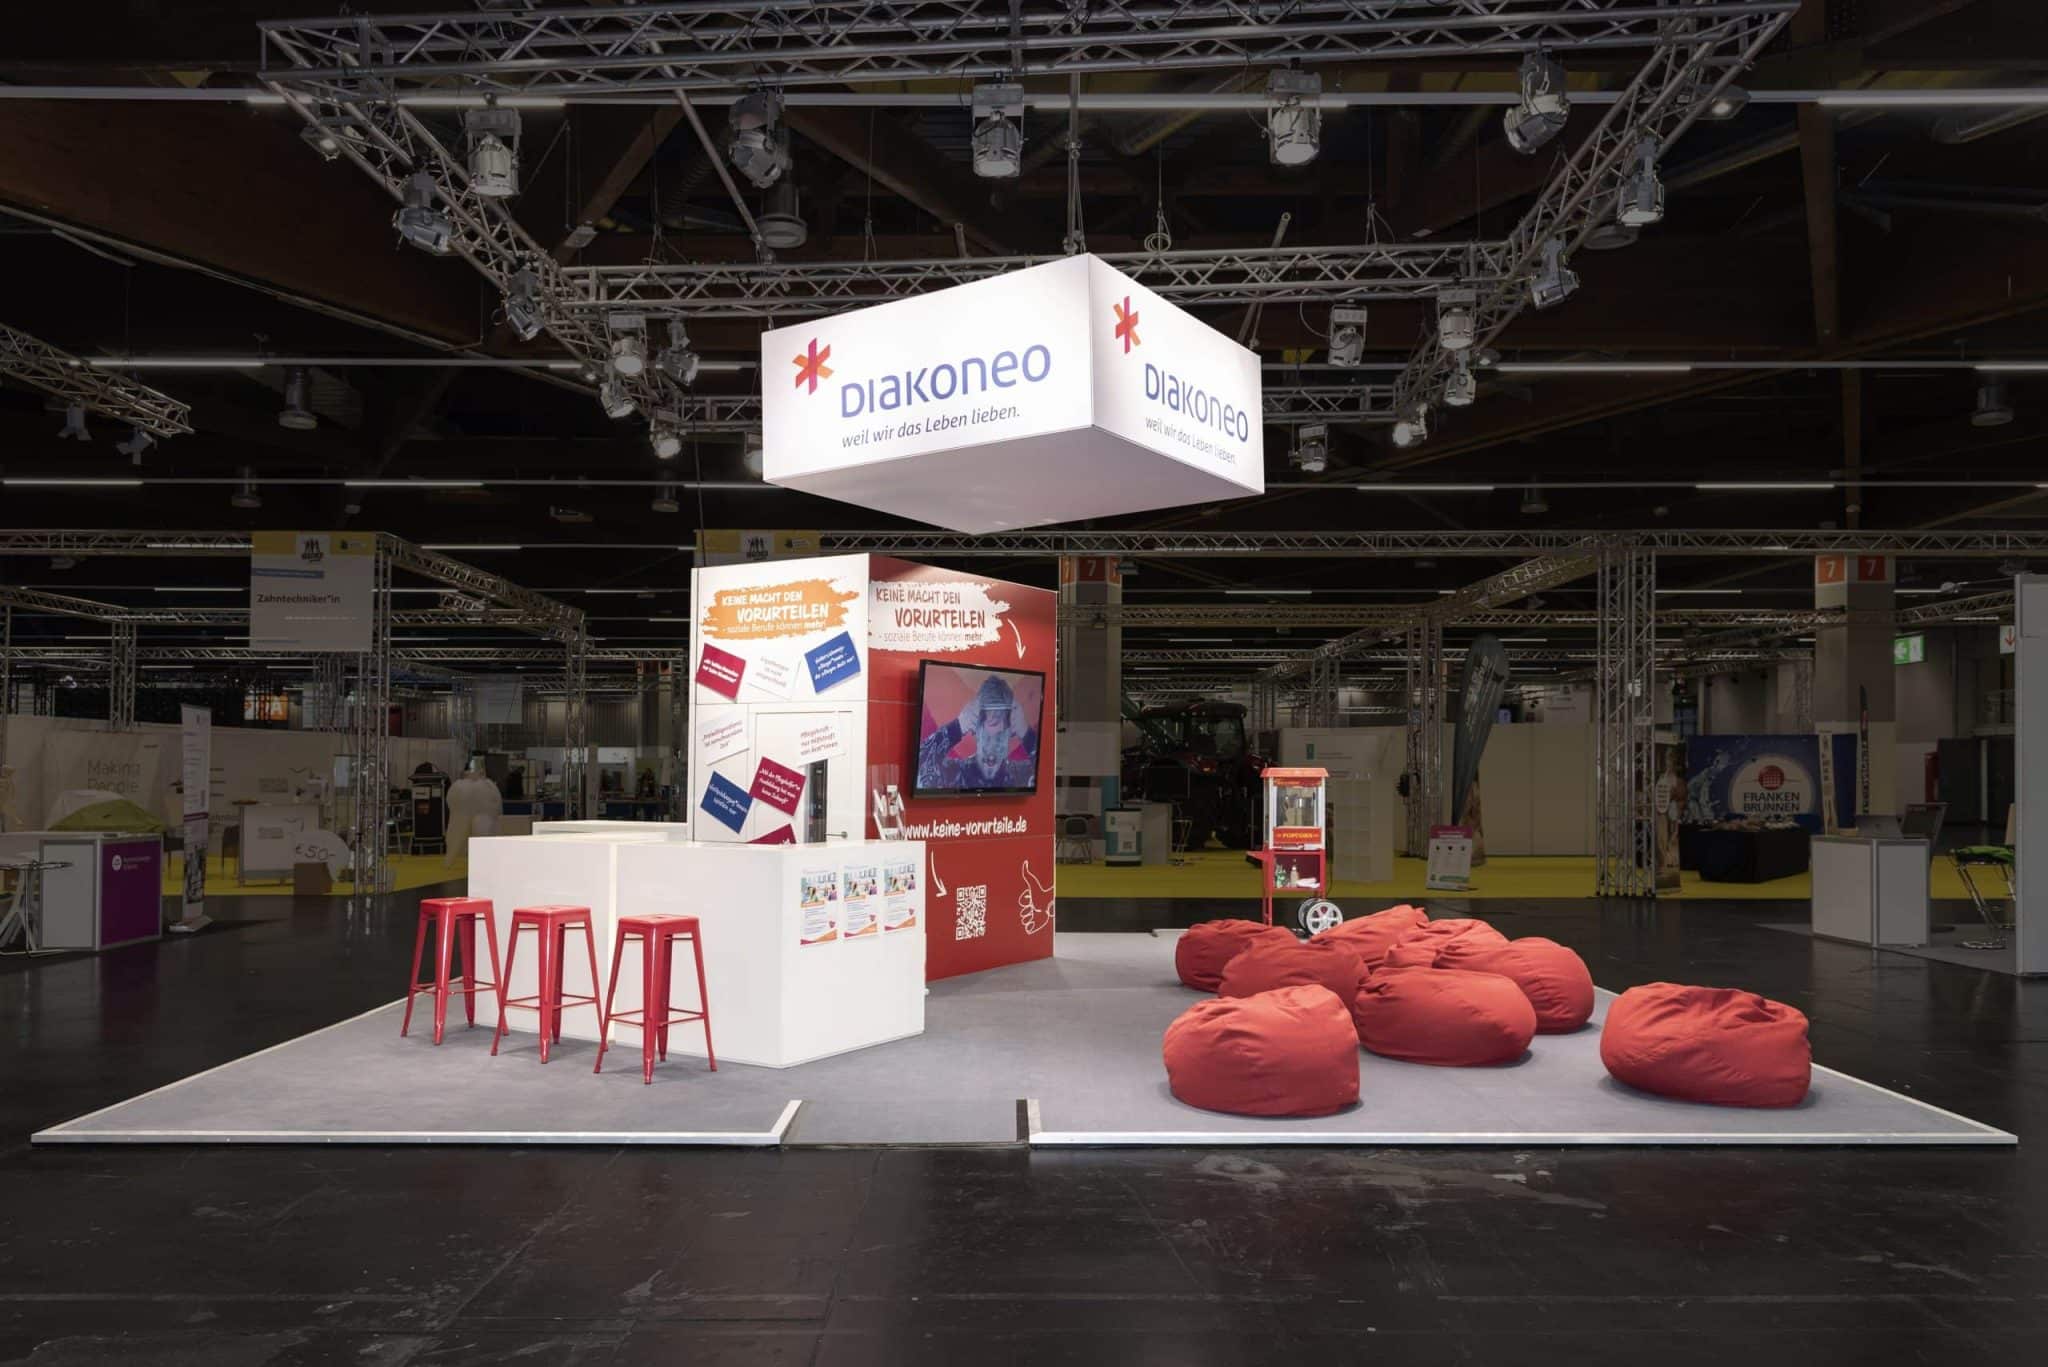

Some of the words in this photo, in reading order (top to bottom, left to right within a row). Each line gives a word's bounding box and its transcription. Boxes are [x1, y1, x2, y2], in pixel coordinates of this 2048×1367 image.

[842, 430, 869, 448] weil
[873, 426, 895, 443] wir
[897, 422, 921, 438] das
[925, 413, 967, 433] Leben
[971, 404, 1020, 425] lieben.
[1145, 416, 1163, 434] weil
[1164, 424, 1176, 438] wir
[1088, 559, 1097, 576] 7
[1826, 560, 1837, 578] 7
[1866, 559, 1877, 575] 7
[722, 595, 747, 606] KEINE
[750, 592, 781, 603] MACHT
[784, 590, 803, 602] DEN
[876, 587, 905, 602] KEINE
[907, 589, 940, 604] MACHT
[943, 591, 960, 604] DEN
[736, 602, 829, 623] VORURTEILEN
[895, 608, 986, 628] VORURTEILEN
[1743, 791, 1800, 802] FRANKEN
[1743, 803, 1800, 812] BRUNNEN
[905, 815, 1028, 839] www.keine-vorurteile.de
